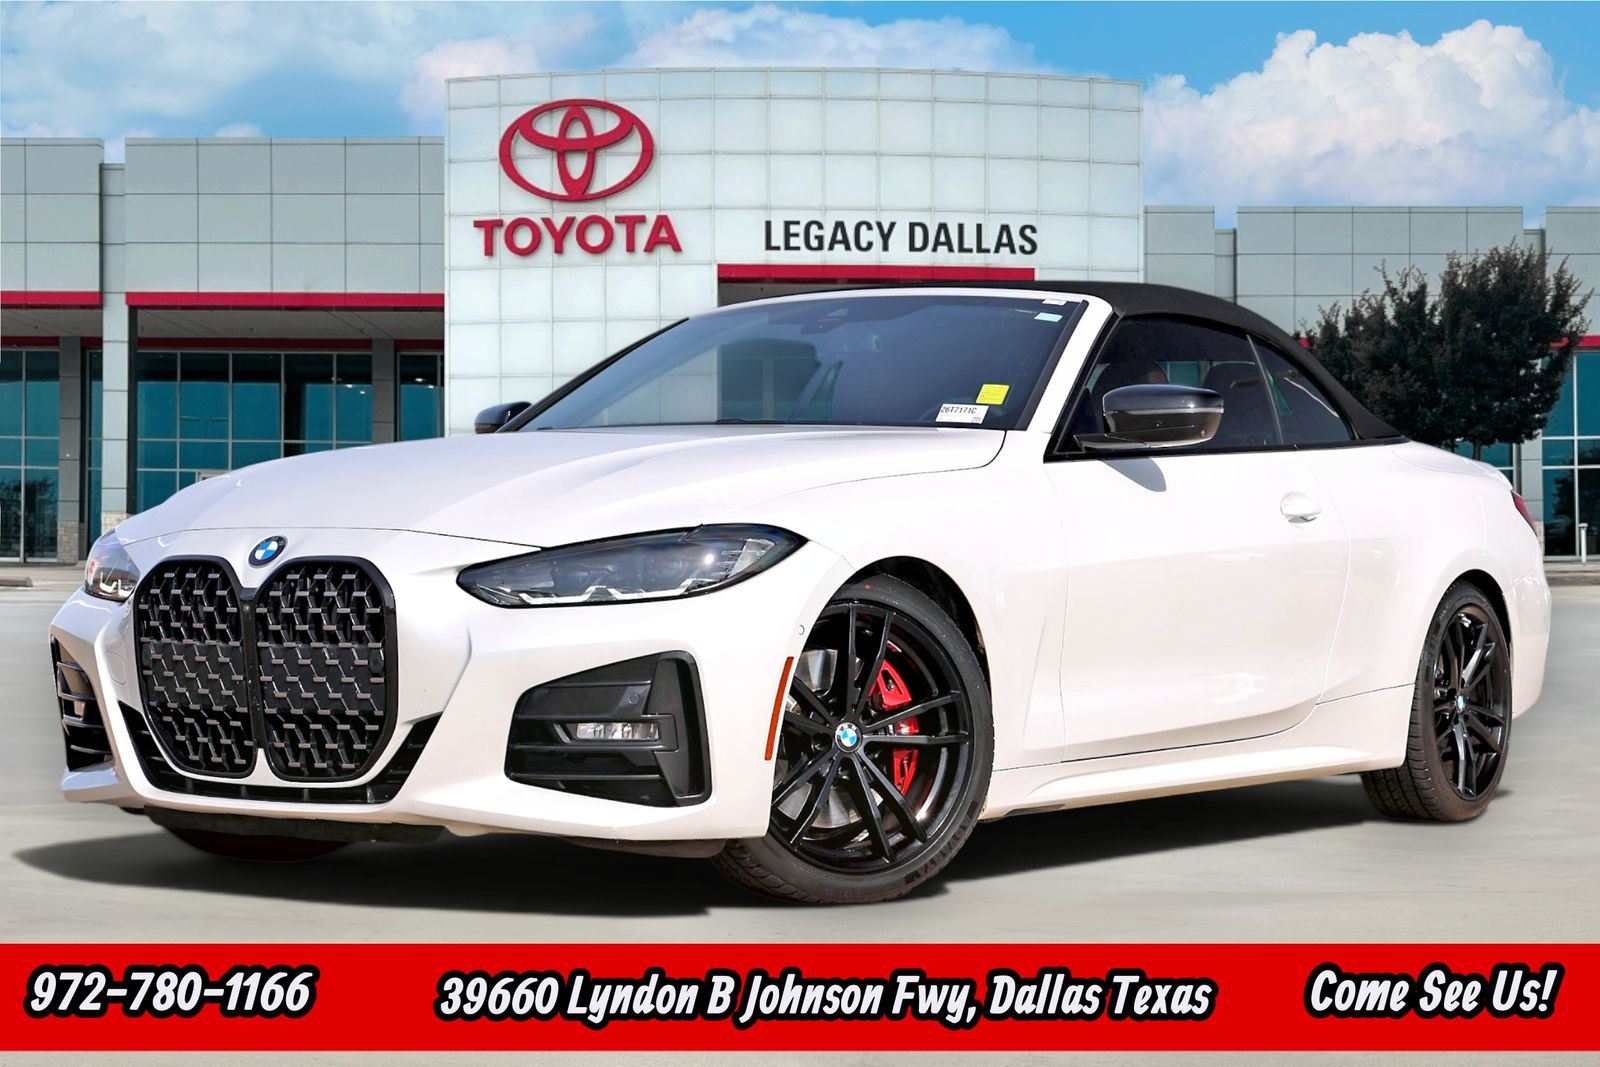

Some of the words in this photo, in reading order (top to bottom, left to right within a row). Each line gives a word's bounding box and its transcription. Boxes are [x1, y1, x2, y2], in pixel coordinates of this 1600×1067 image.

[474, 214, 682, 257] TOYOTA
[765, 220, 897, 252] LEGACY
[908, 221, 1038, 255] DALLAS
